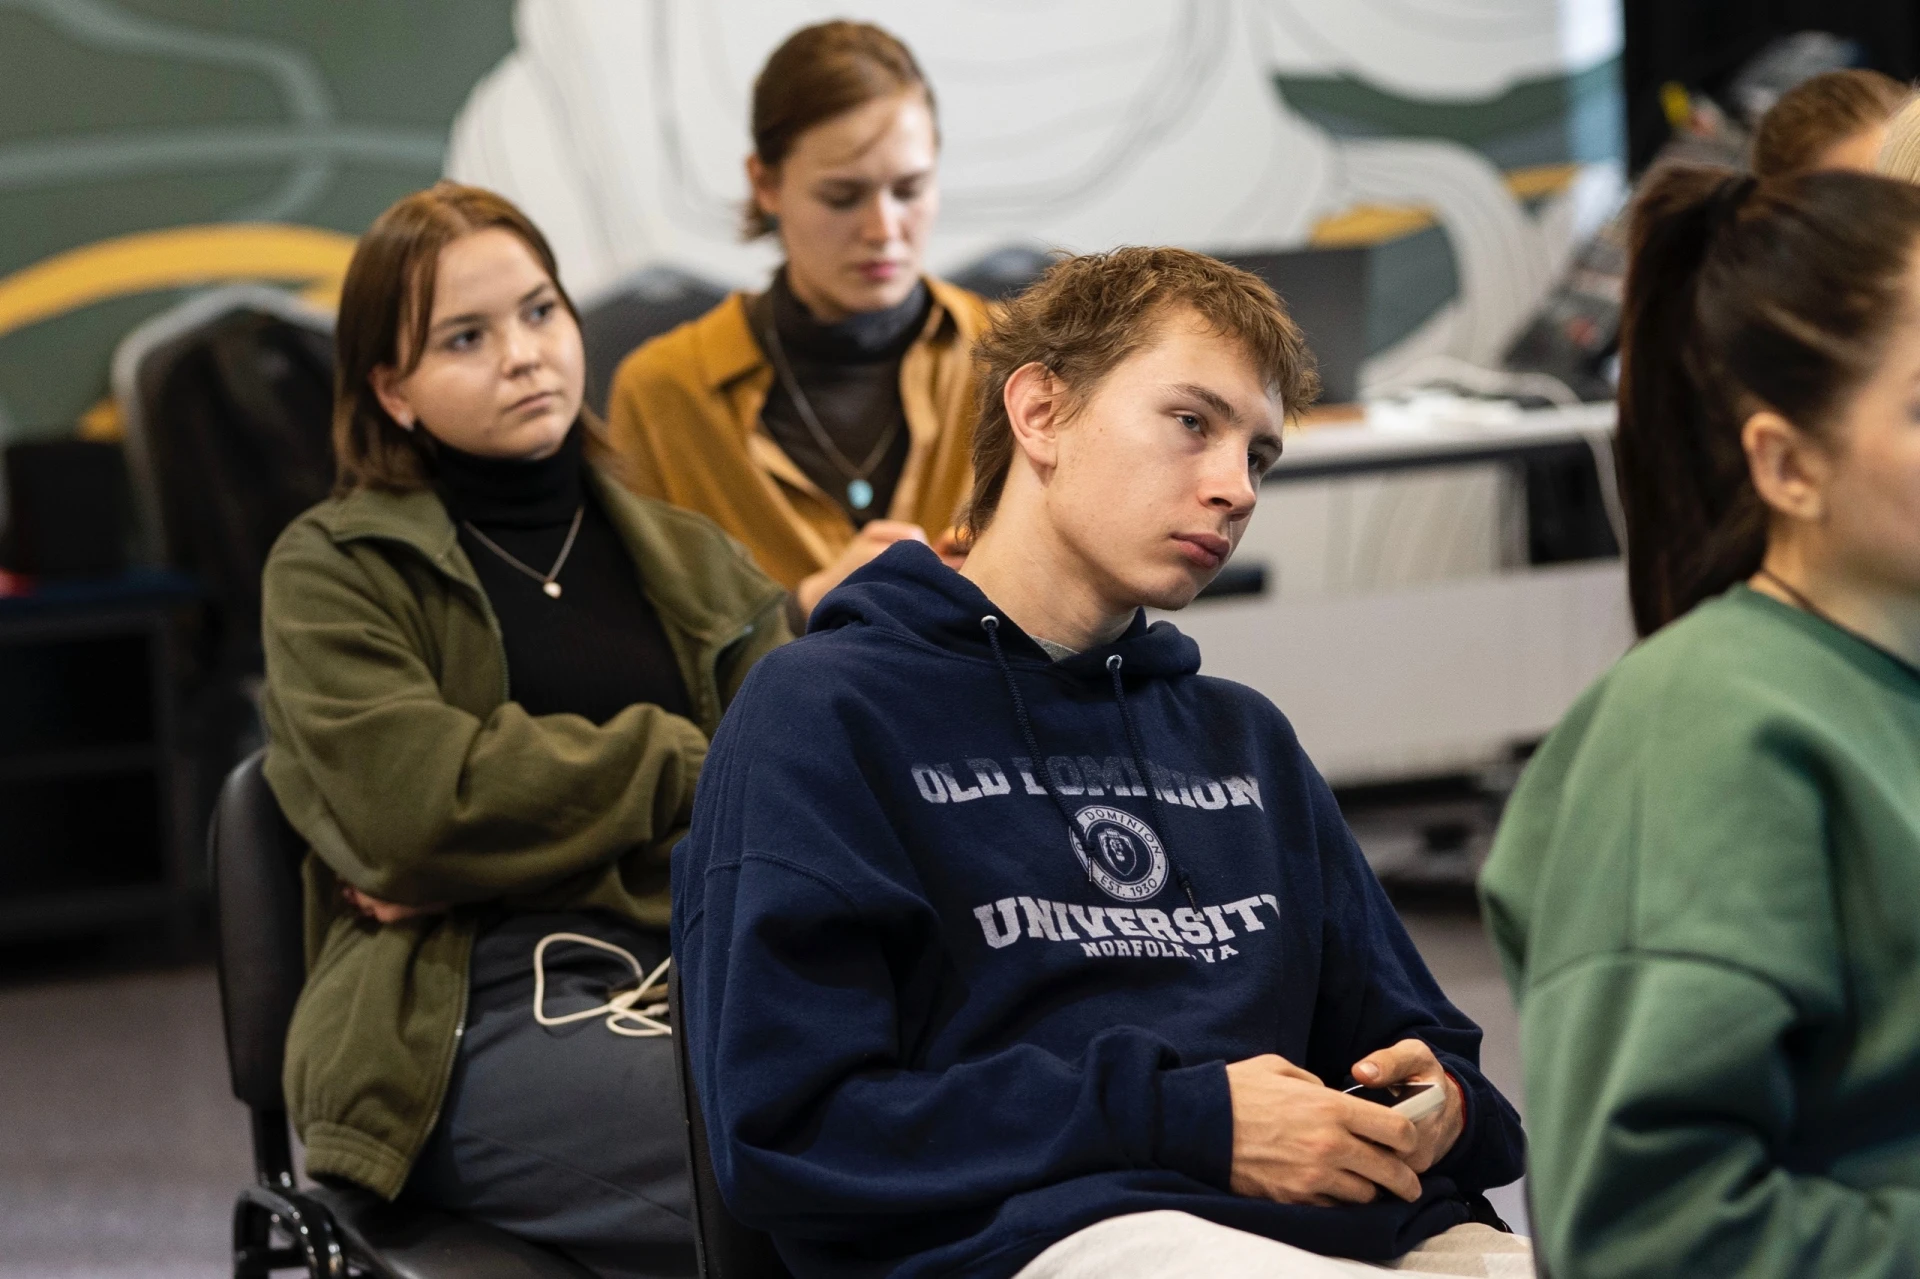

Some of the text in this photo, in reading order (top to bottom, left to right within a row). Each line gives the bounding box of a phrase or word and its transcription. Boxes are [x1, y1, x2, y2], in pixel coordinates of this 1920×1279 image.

[911, 758, 1011, 803] OLD
[1084, 809, 1162, 855] DOMINION
[1100, 875, 1158, 897] EST. 1930
[1198, 944, 1240, 964] VA
